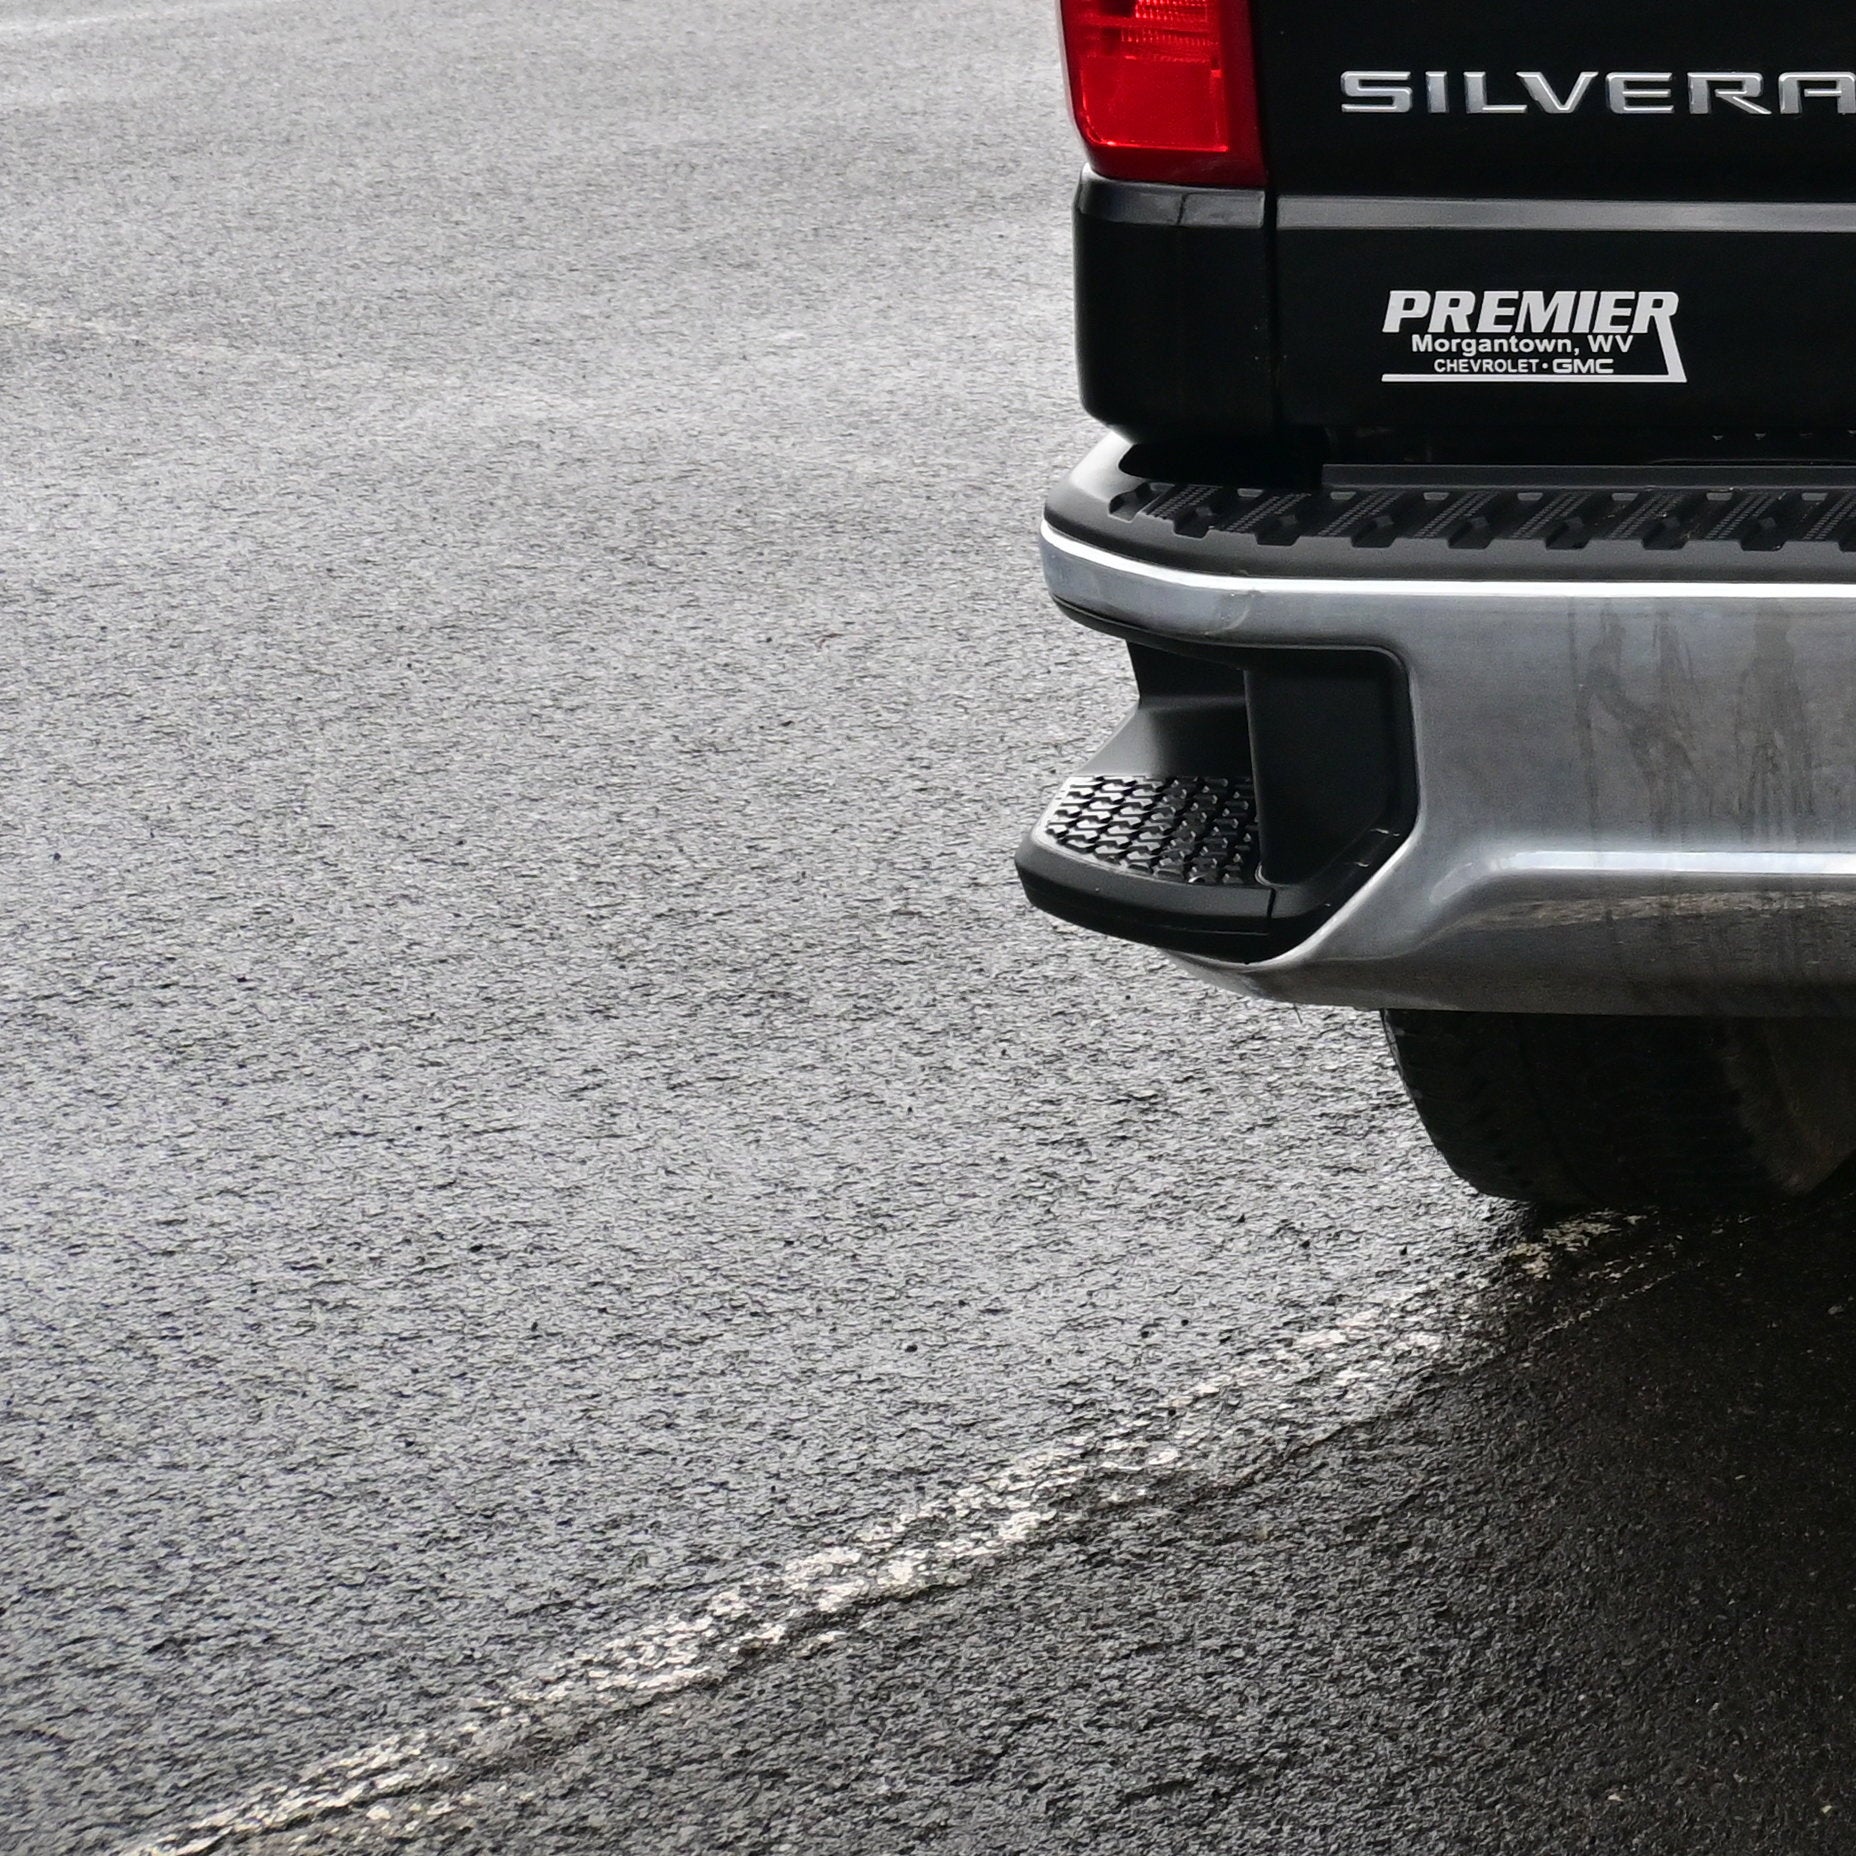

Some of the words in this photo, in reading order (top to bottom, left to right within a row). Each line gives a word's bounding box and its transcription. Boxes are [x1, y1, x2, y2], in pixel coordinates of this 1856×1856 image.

[1382, 290, 1680, 334] PREMIER
[1411, 334, 1581, 357] Morgantown,
[1587, 334, 1634, 353] WV
[1433, 358, 1540, 374] CHEVROLET
[1552, 358, 1615, 374] GMC
